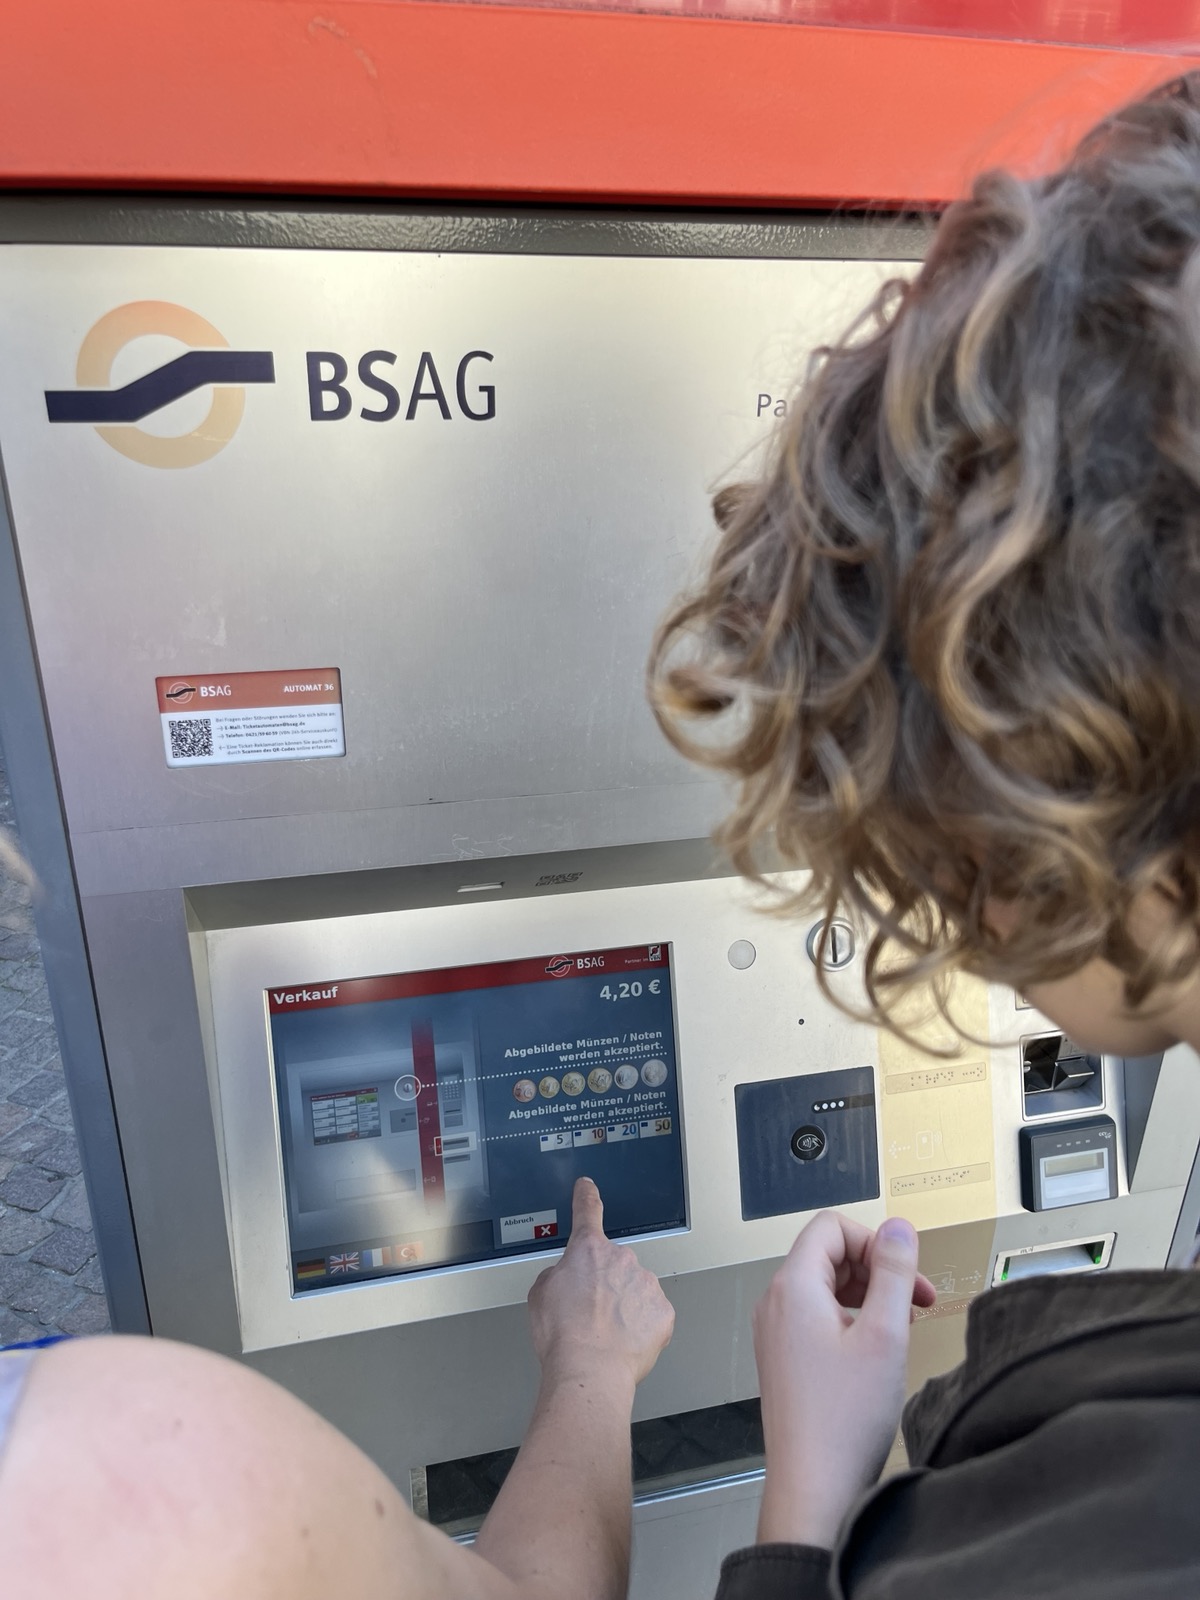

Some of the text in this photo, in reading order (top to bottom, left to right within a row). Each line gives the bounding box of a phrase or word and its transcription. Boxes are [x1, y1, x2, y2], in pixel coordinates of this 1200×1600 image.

[305, 349, 498, 423] BSAG
[756, 393, 789, 418] Pa
[200, 685, 232, 697] BSAG
[283, 683, 334, 693] AUTOMAT 36
[576, 955, 605, 970] BSAG
[273, 985, 339, 1005] Verkauf
[599, 979, 661, 1002] 4,20 €
[504, 1042, 573, 1058] Abgebildete
[576, 1035, 619, 1048] Münzen
[629, 1030, 663, 1042] Noten
[559, 1041, 664, 1063] werden akzeptiert.
[508, 1103, 578, 1120] Abgebildete
[580, 1097, 624, 1110] Münzen
[633, 1090, 667, 1103] Noten
[562, 1101, 668, 1124] werden akzeptiert.
[556, 1119, 670, 1144] 5 10 20 50
[504, 1216, 535, 1227] Abbruch
